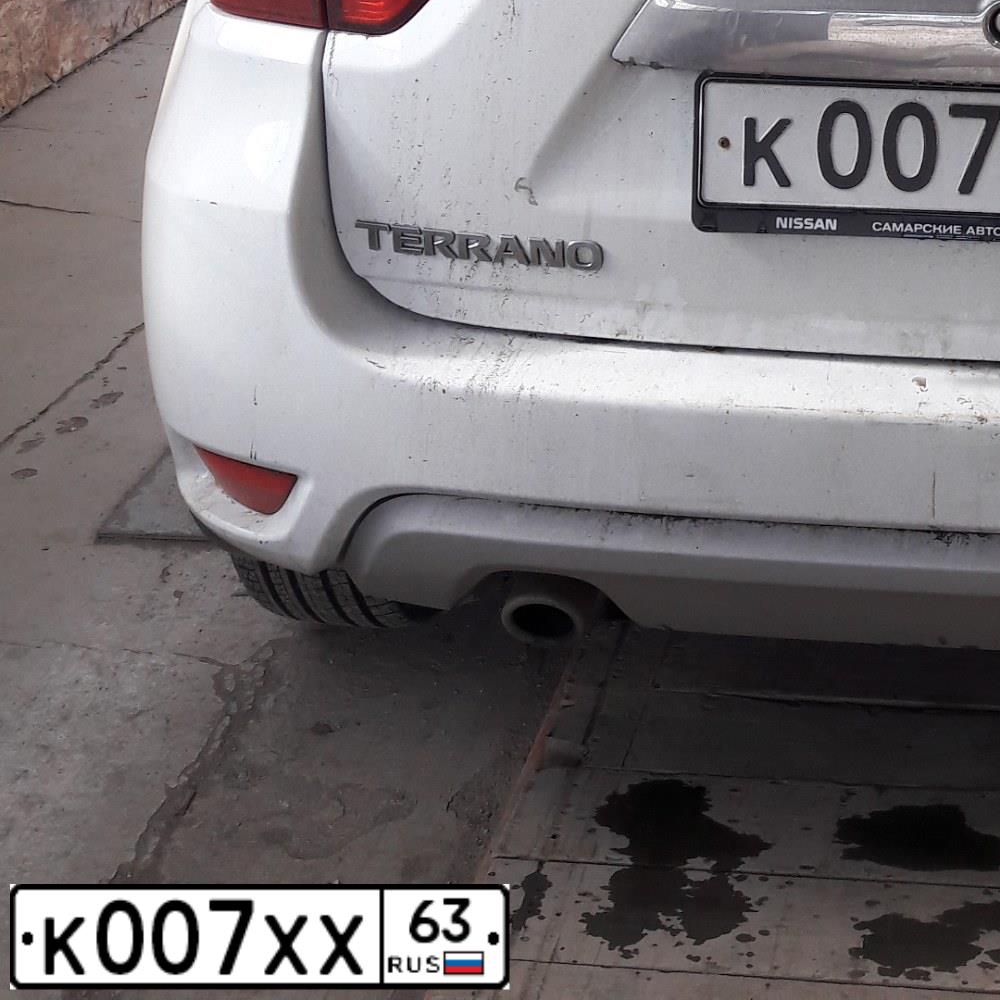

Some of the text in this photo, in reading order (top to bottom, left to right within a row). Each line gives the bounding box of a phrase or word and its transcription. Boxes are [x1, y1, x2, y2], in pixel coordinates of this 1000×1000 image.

[775, 216, 838, 231] NISSAN
[872, 221, 962, 236] САМАРСКИЕ
[354, 219, 605, 271] TERRANO
